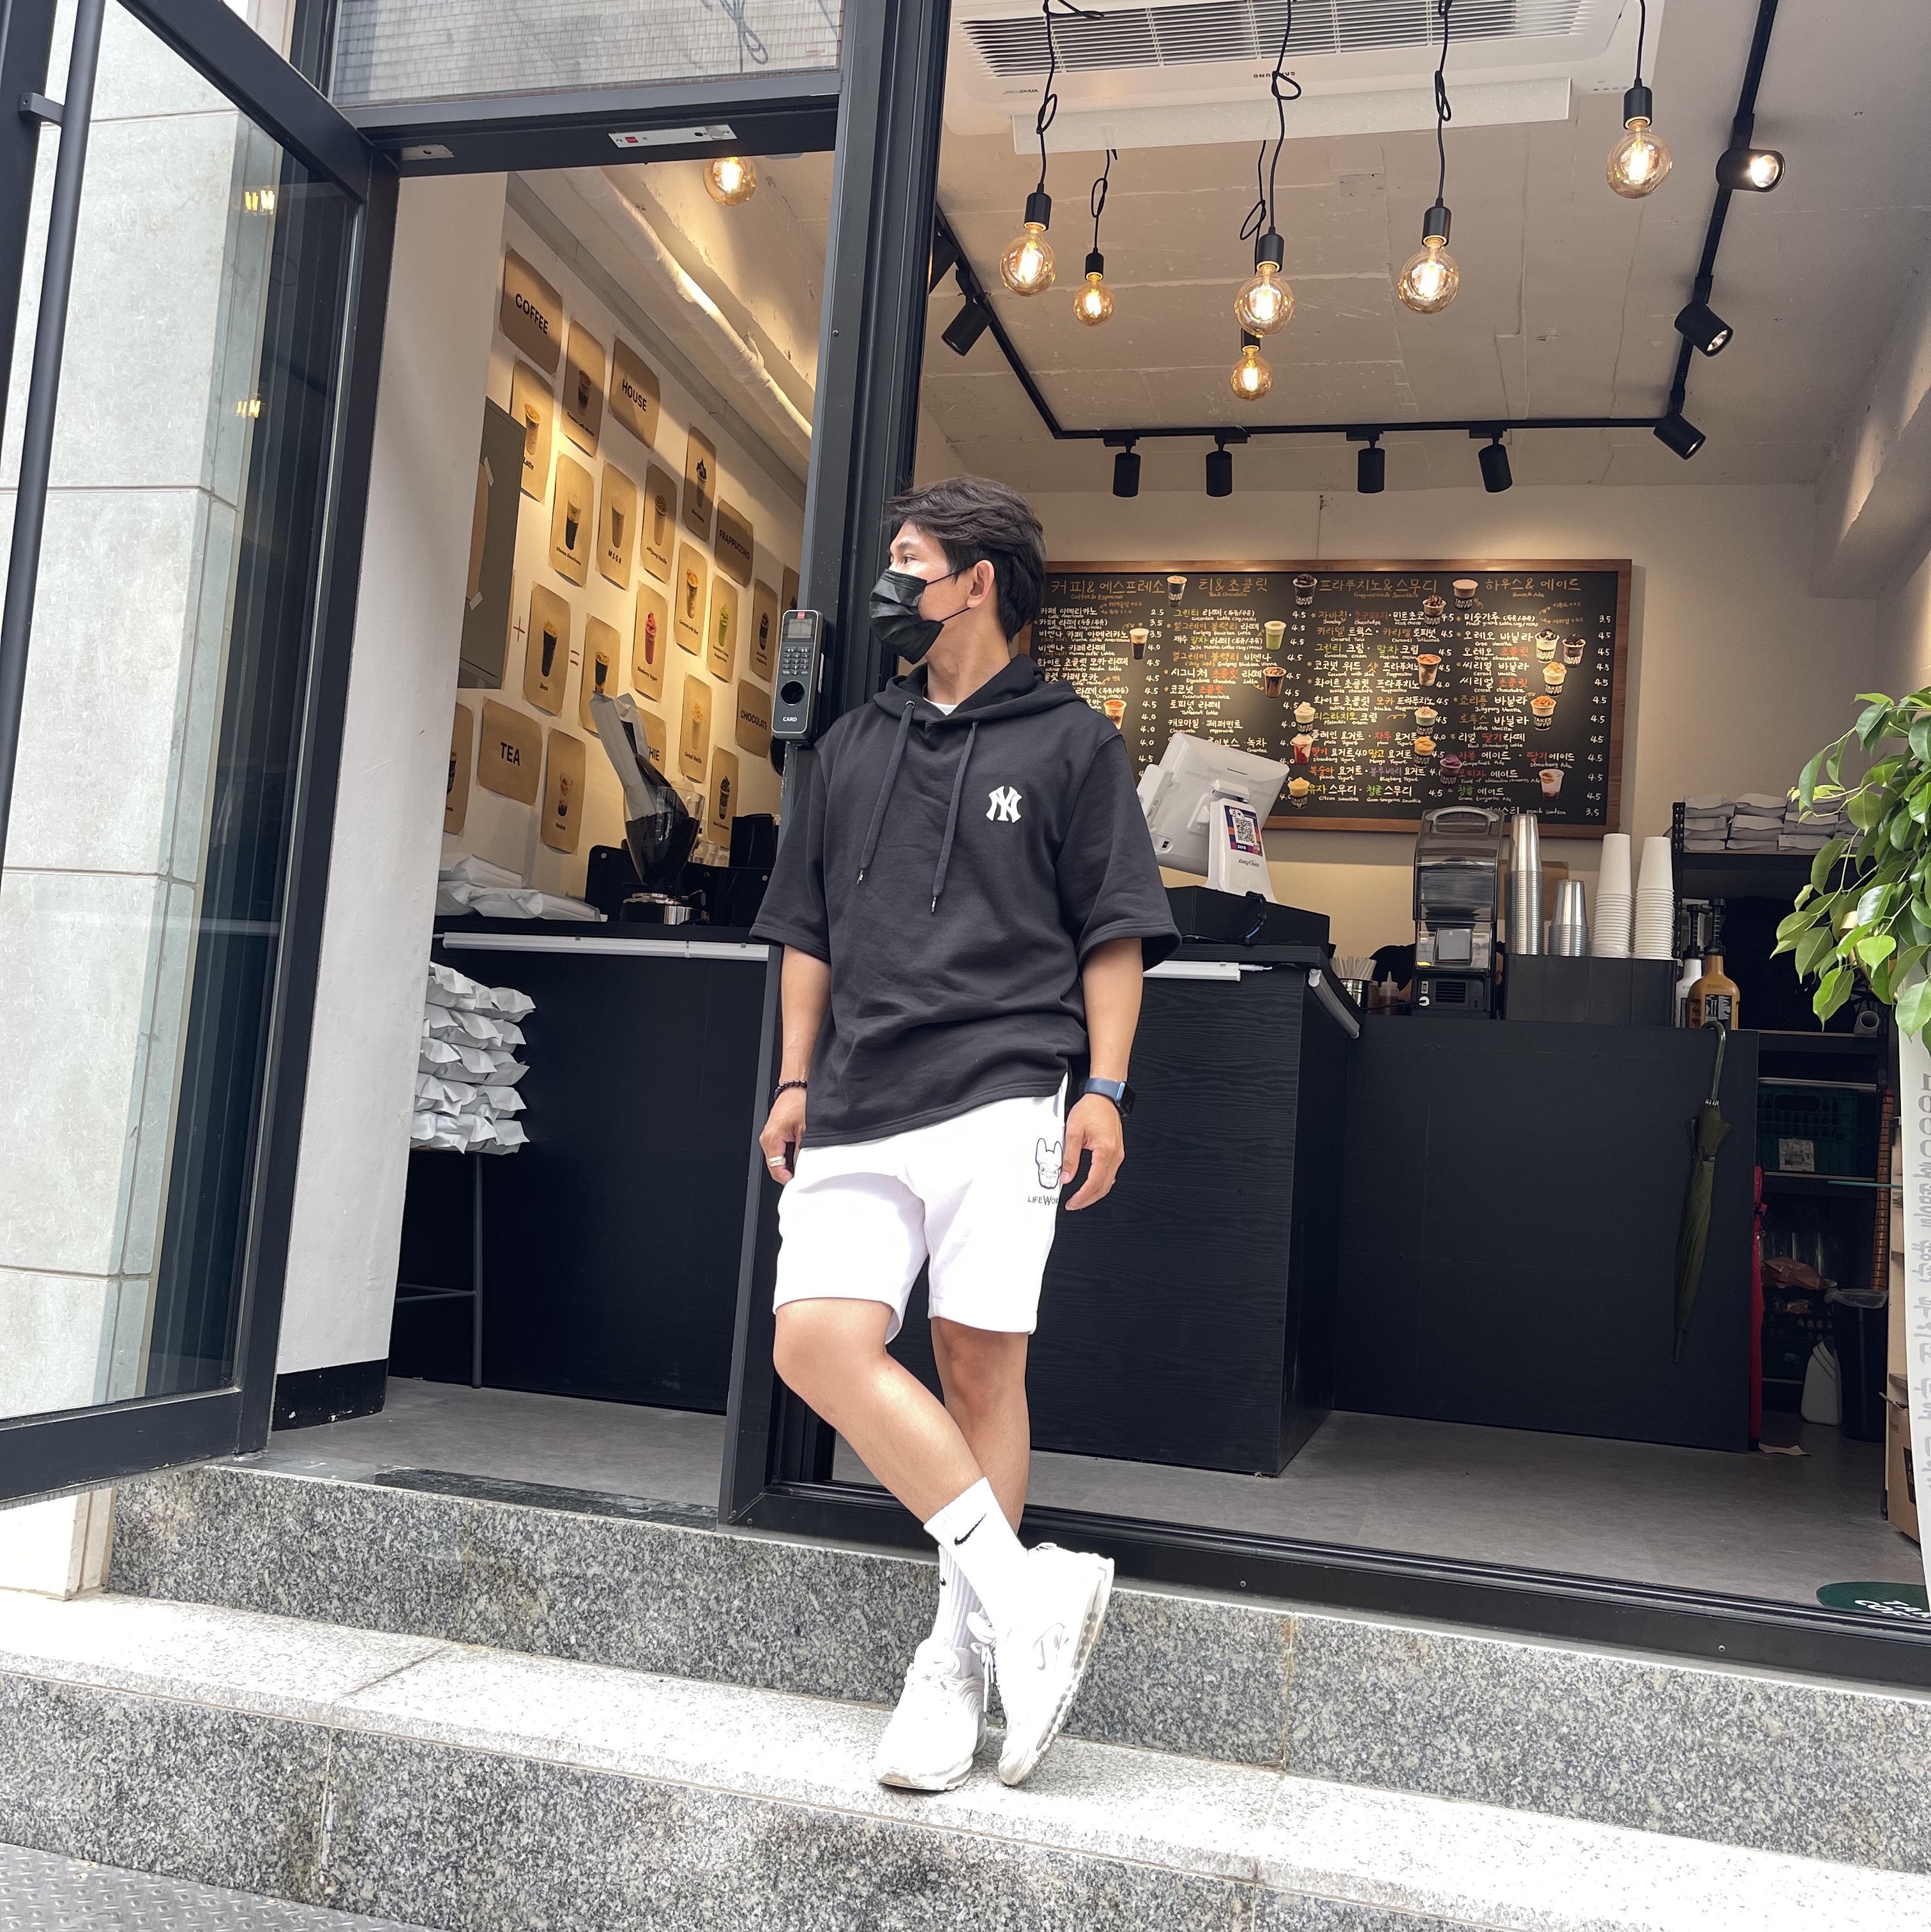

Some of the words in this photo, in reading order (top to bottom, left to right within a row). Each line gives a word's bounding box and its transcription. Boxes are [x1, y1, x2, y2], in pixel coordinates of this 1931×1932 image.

[515, 293, 549, 335] COFFEE
[622, 379, 647, 412] HOUSE
[719, 529, 750, 559] FRAPPUCCINO
[608, 549, 622, 565] MSGR
[1051, 579, 1095, 594] 커피&
[1099, 579, 1165, 594] 에스프레소
[1540, 577, 1581, 591] 에이드
[1060, 607, 1098, 616] 아메리카노
[1173, 609, 1199, 618] 그린티
[1317, 610, 1348, 622] 자바칩
[1354, 611, 1388, 621] 초코퍼지
[1393, 611, 1425, 621] 민트초코
[1441, 613, 1455, 621] 4.5
[1464, 611, 1500, 623] 미숫가루
[1599, 614, 1611, 623] 3.5
[1174, 621, 1207, 632] 얼그레이
[1211, 621, 1238, 632] 블랙티
[1240, 622, 1259, 632] 라떼
[1317, 626, 1345, 637] 카라멜
[1347, 626, 1373, 637] 트윅스
[1382, 627, 1412, 637] 카라멜
[1039, 630, 1063, 639] 비엔나
[1066, 630, 1084, 639] 카페
[1087, 630, 1129, 639] 아메리카노
[1149, 630, 1162, 638] 3.5
[1173, 635, 1188, 644] 제주
[1463, 630, 1496, 641] 오레오
[1499, 631, 1534, 644] 바닐라
[1038, 644, 1065, 652] 비엔나
[1314, 643, 1342, 654] 그린티
[1345, 643, 1365, 654] 크림
[1377, 644, 1399, 655] 말차
[1400, 644, 1419, 655] 크림
[1438, 648, 1452, 657] 4.5
[1462, 647, 1495, 657] 오레오
[1500, 646, 1530, 657] 초콜릿
[1597, 648, 1610, 657] 4.5
[1037, 658, 1062, 667] 화이트
[1064, 657, 1087, 668] 초콜릿
[1172, 651, 1207, 662] 얼그레이
[1211, 651, 1239, 662] 블랙티
[1243, 652, 1272, 662] 비엔나
[1287, 653, 1303, 662] 4.5
[1313, 660, 1338, 671] 코코넛
[1342, 660, 1361, 671] 위드
[1382, 662, 1419, 672] 프라푸치노
[1438, 664, 1451, 673] 4.5
[1462, 660, 1492, 672] 씨리얼
[1498, 661, 1530, 673] 바닐라
[1596, 663, 1610, 672] 4.5
[1170, 667, 1208, 678] 시그니처
[1212, 667, 1239, 680] 초콜릿
[1241, 669, 1262, 678] 라떼
[1285, 672, 1301, 680] 4.5
[1314, 677, 1341, 688] 화이트
[1344, 678, 1370, 690] 초콜릿
[1375, 679, 1421, 690] 프라푸치노
[1436, 680, 1450, 688] 4.0
[1459, 676, 1494, 689] 씨리얼
[1499, 678, 1529, 688] 초콜릿
[1594, 678, 1609, 687] 4.5
[1169, 684, 1194, 695] 코코넛
[1199, 684, 1224, 695] 초콜릿
[1284, 688, 1300, 697] 4.5
[1142, 700, 1158, 709] 4.5
[1169, 700, 1195, 711] 토피넛
[1197, 701, 1221, 710] 라떼
[1283, 701, 1299, 710] 4.5
[1313, 695, 1340, 704] 화이트
[1343, 696, 1370, 707] 초콜릿
[1436, 697, 1449, 706] 4.5
[1458, 695, 1488, 706] 죠리퐁
[1494, 695, 1528, 707] 바닐라
[1593, 696, 1607, 704] 4.5
[741, 710, 768, 731] CHOCOLATE
[1359, 711, 1378, 723] 크림
[1494, 715, 1529, 727] 바닐라
[1590, 714, 1605, 724] 4.5
[1140, 725, 1156, 733] 4.0
[1206, 720, 1243, 729] 페퍼민트
[1312, 729, 1338, 741] 플레인
[1340, 731, 1365, 741] 요거트
[1374, 731, 1392, 741] 자두
[1394, 732, 1418, 741] 요거트
[1458, 732, 1476, 743] 리얼
[1590, 735, 1604, 743] 4.5
[1246, 737, 1268, 747] 녹차
[501, 742, 520, 766] TEA
[1311, 747, 1328, 757] 딸기
[1331, 748, 1355, 757] 요거트
[1354, 749, 1368, 757] 4.0
[1368, 749, 1385, 759] 망고
[1387, 749, 1412, 759] 요거트
[1432, 750, 1445, 759] 4.5
[1481, 750, 1511, 761] 에이드
[1587, 754, 1603, 763] 4.5
[1138, 755, 1154, 763] 4.5
[1309, 765, 1335, 776] 복숭아
[1337, 765, 1363, 775] 요거트
[1369, 766, 1402, 777] 블루베리
[1404, 767, 1427, 776] 요거트
[1458, 769, 1487, 779] 오미자
[1490, 769, 1518, 779] 에이드
[1587, 772, 1603, 781] 4.5
[1308, 784, 1328, 795] 유자
[1428, 789, 1443, 797] 4.5
[1477, 786, 1504, 796] 에이드
[1586, 791, 1602, 800] 4.5
[986, 786, 1022, 823] NY
[1586, 808, 1600, 817] 3.5
